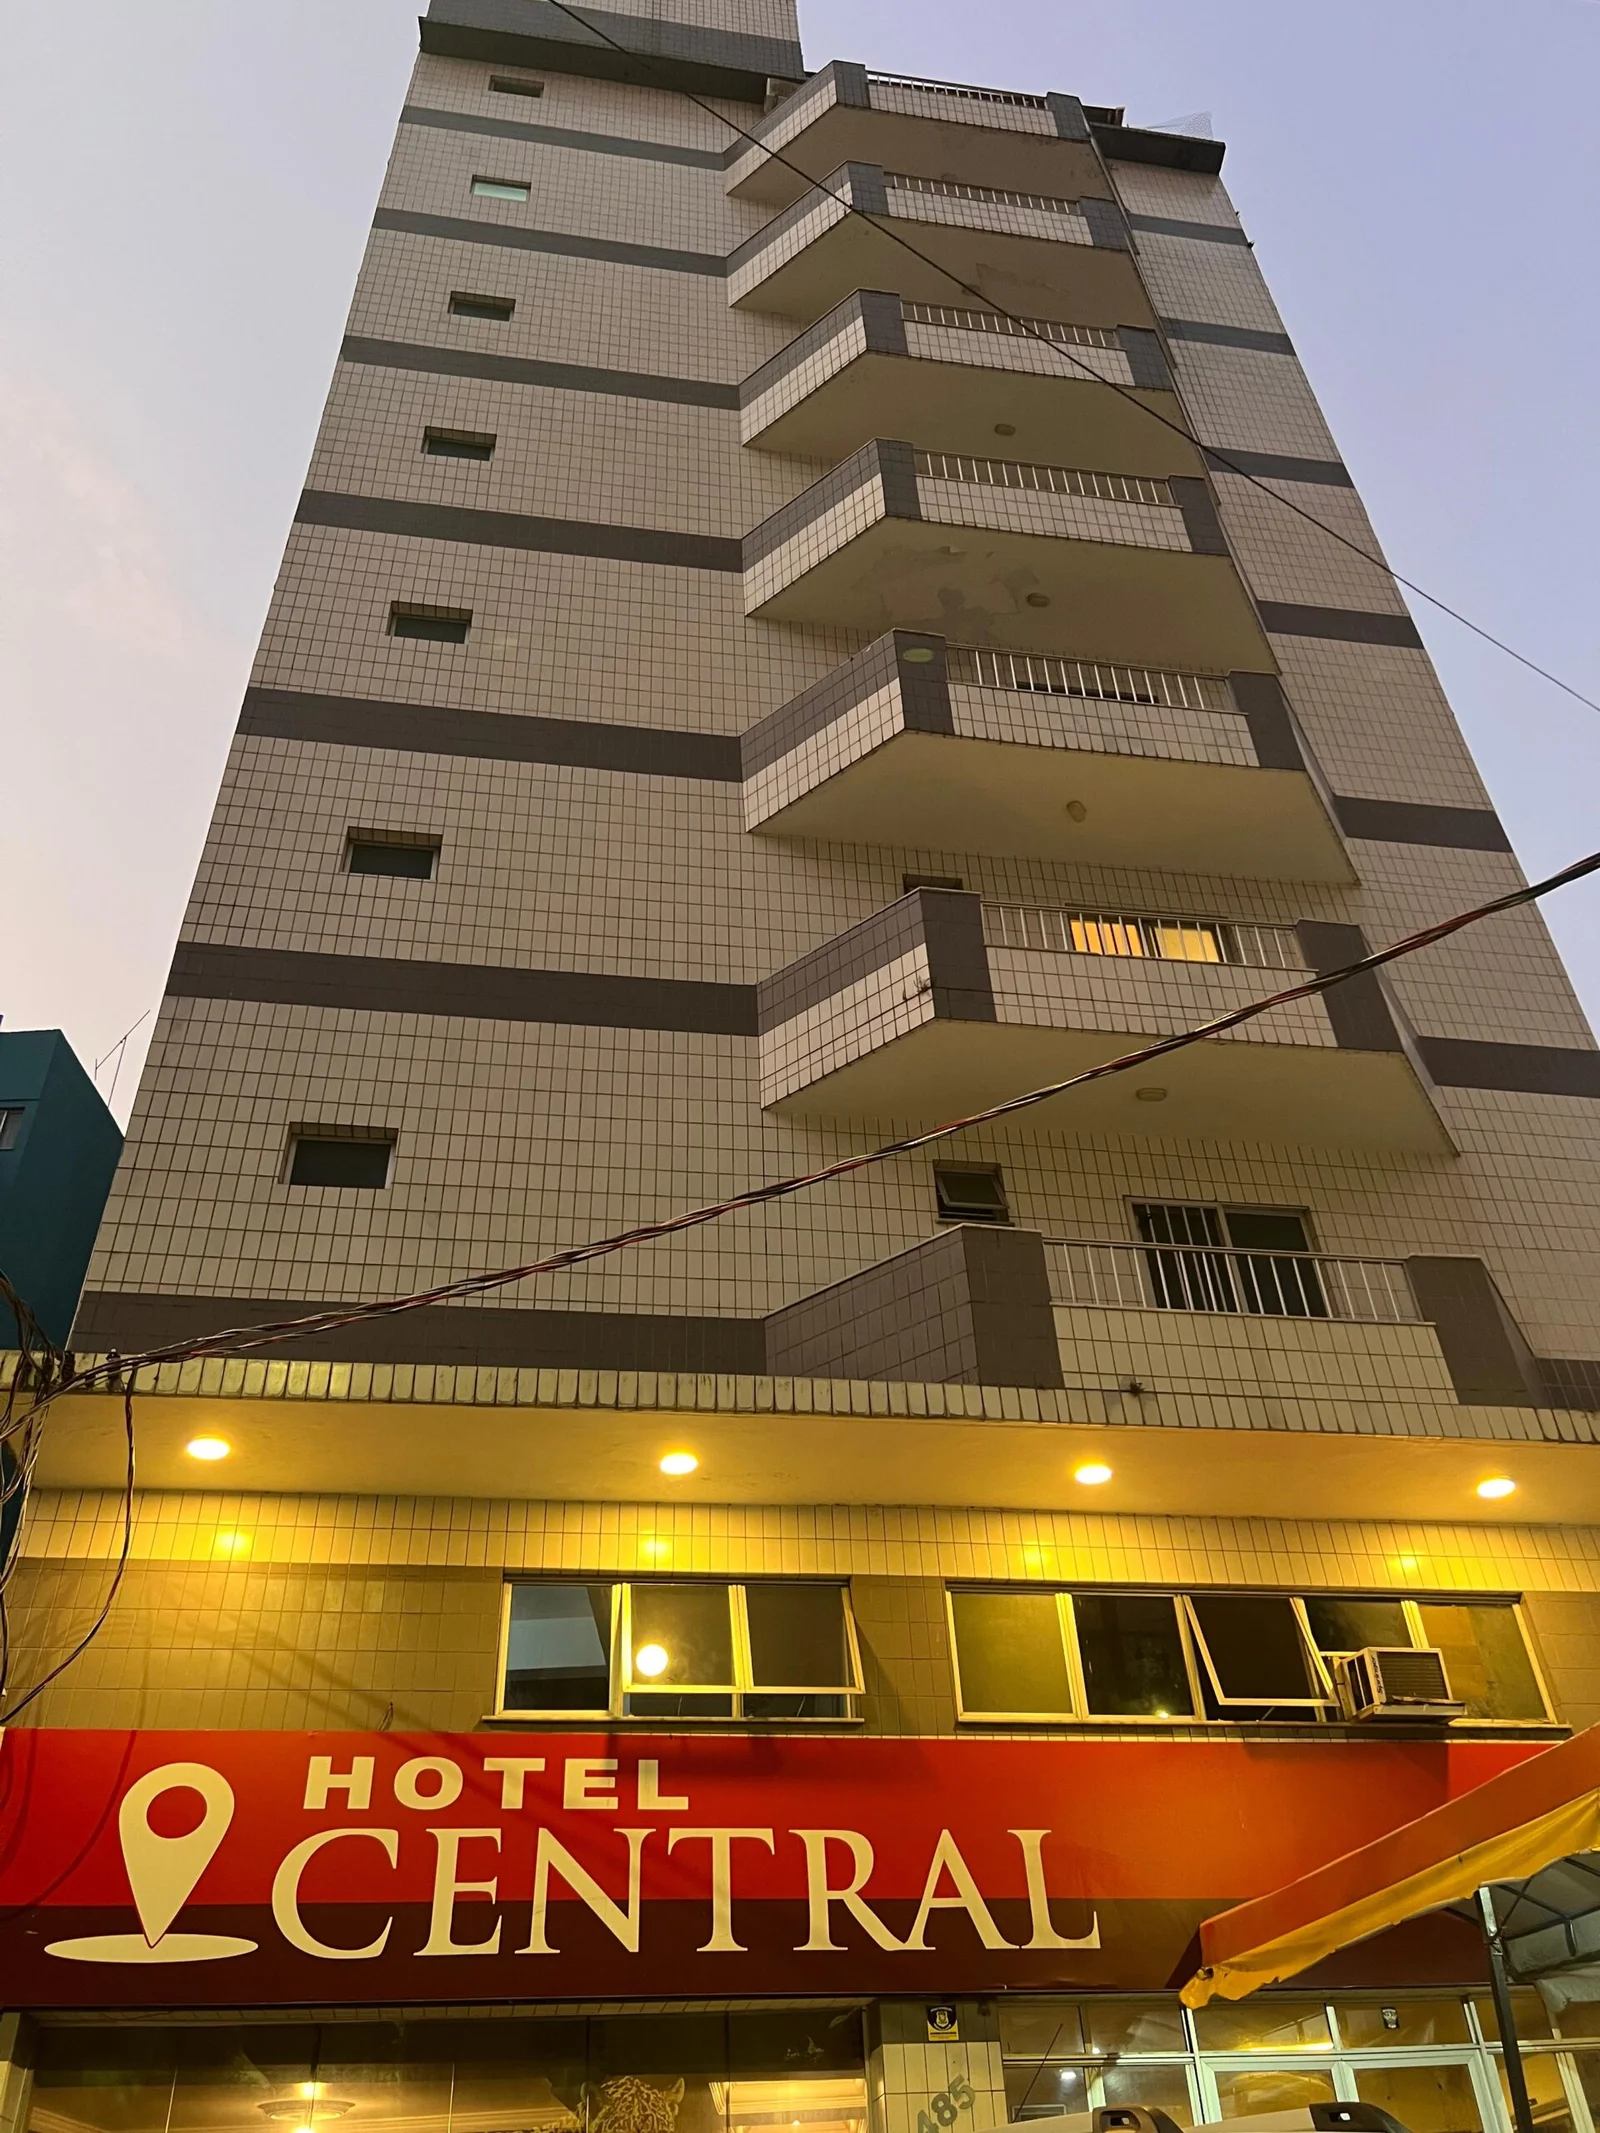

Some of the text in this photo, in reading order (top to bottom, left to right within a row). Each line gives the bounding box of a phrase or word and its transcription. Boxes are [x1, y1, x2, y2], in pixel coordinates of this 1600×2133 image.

[303, 1756, 689, 1810] HOTEL
[271, 1827, 1101, 1959] CENTRAL
[917, 2074, 976, 2133] 485
